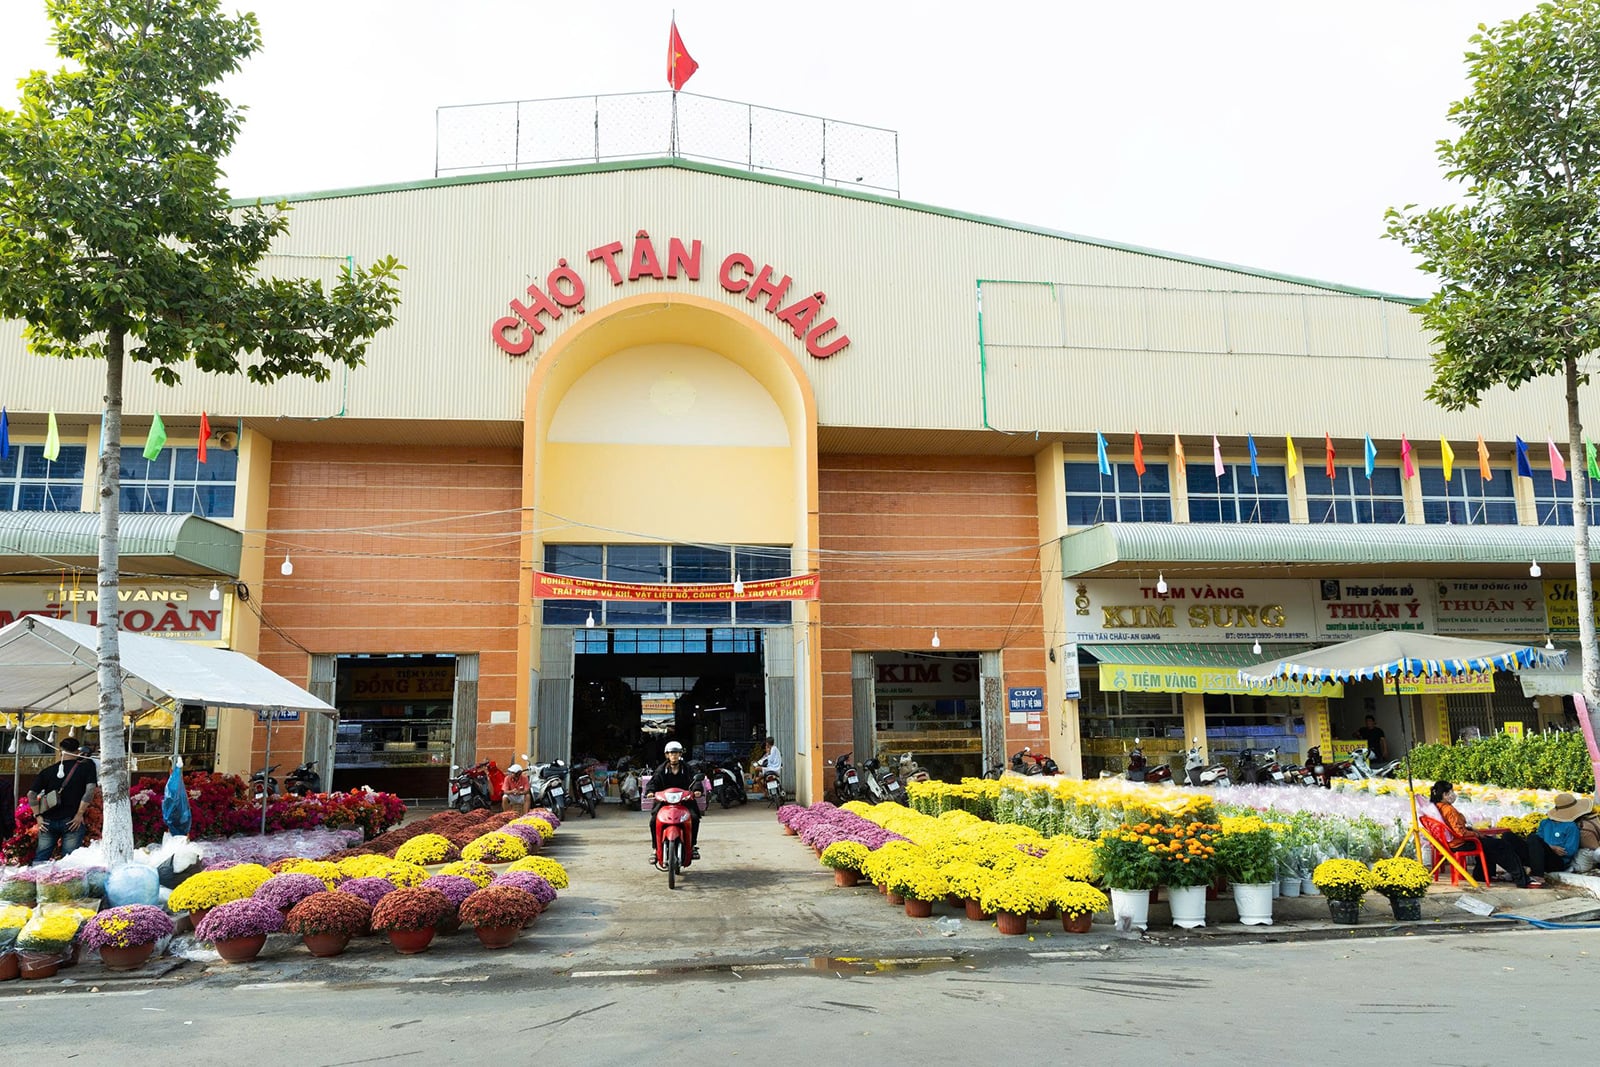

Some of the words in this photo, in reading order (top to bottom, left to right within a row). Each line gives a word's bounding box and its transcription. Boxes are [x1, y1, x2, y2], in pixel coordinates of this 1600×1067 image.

[491, 257, 586, 356] CHỢ
[587, 229, 703, 287] TÂN
[719, 251, 852, 359] CHÂU
[1191, 584, 1245, 599] VÀNG
[1326, 599, 1401, 623] THUẬN
[1404, 598, 1421, 619] Ý
[1439, 598, 1516, 614] THUẬN
[1101, 605, 1177, 629] KIM
[1187, 603, 1287, 630] SUNG
[877, 663, 942, 683] KIM
[1132, 671, 1161, 689] TIỆM
[1164, 673, 1197, 689] VÀNG
